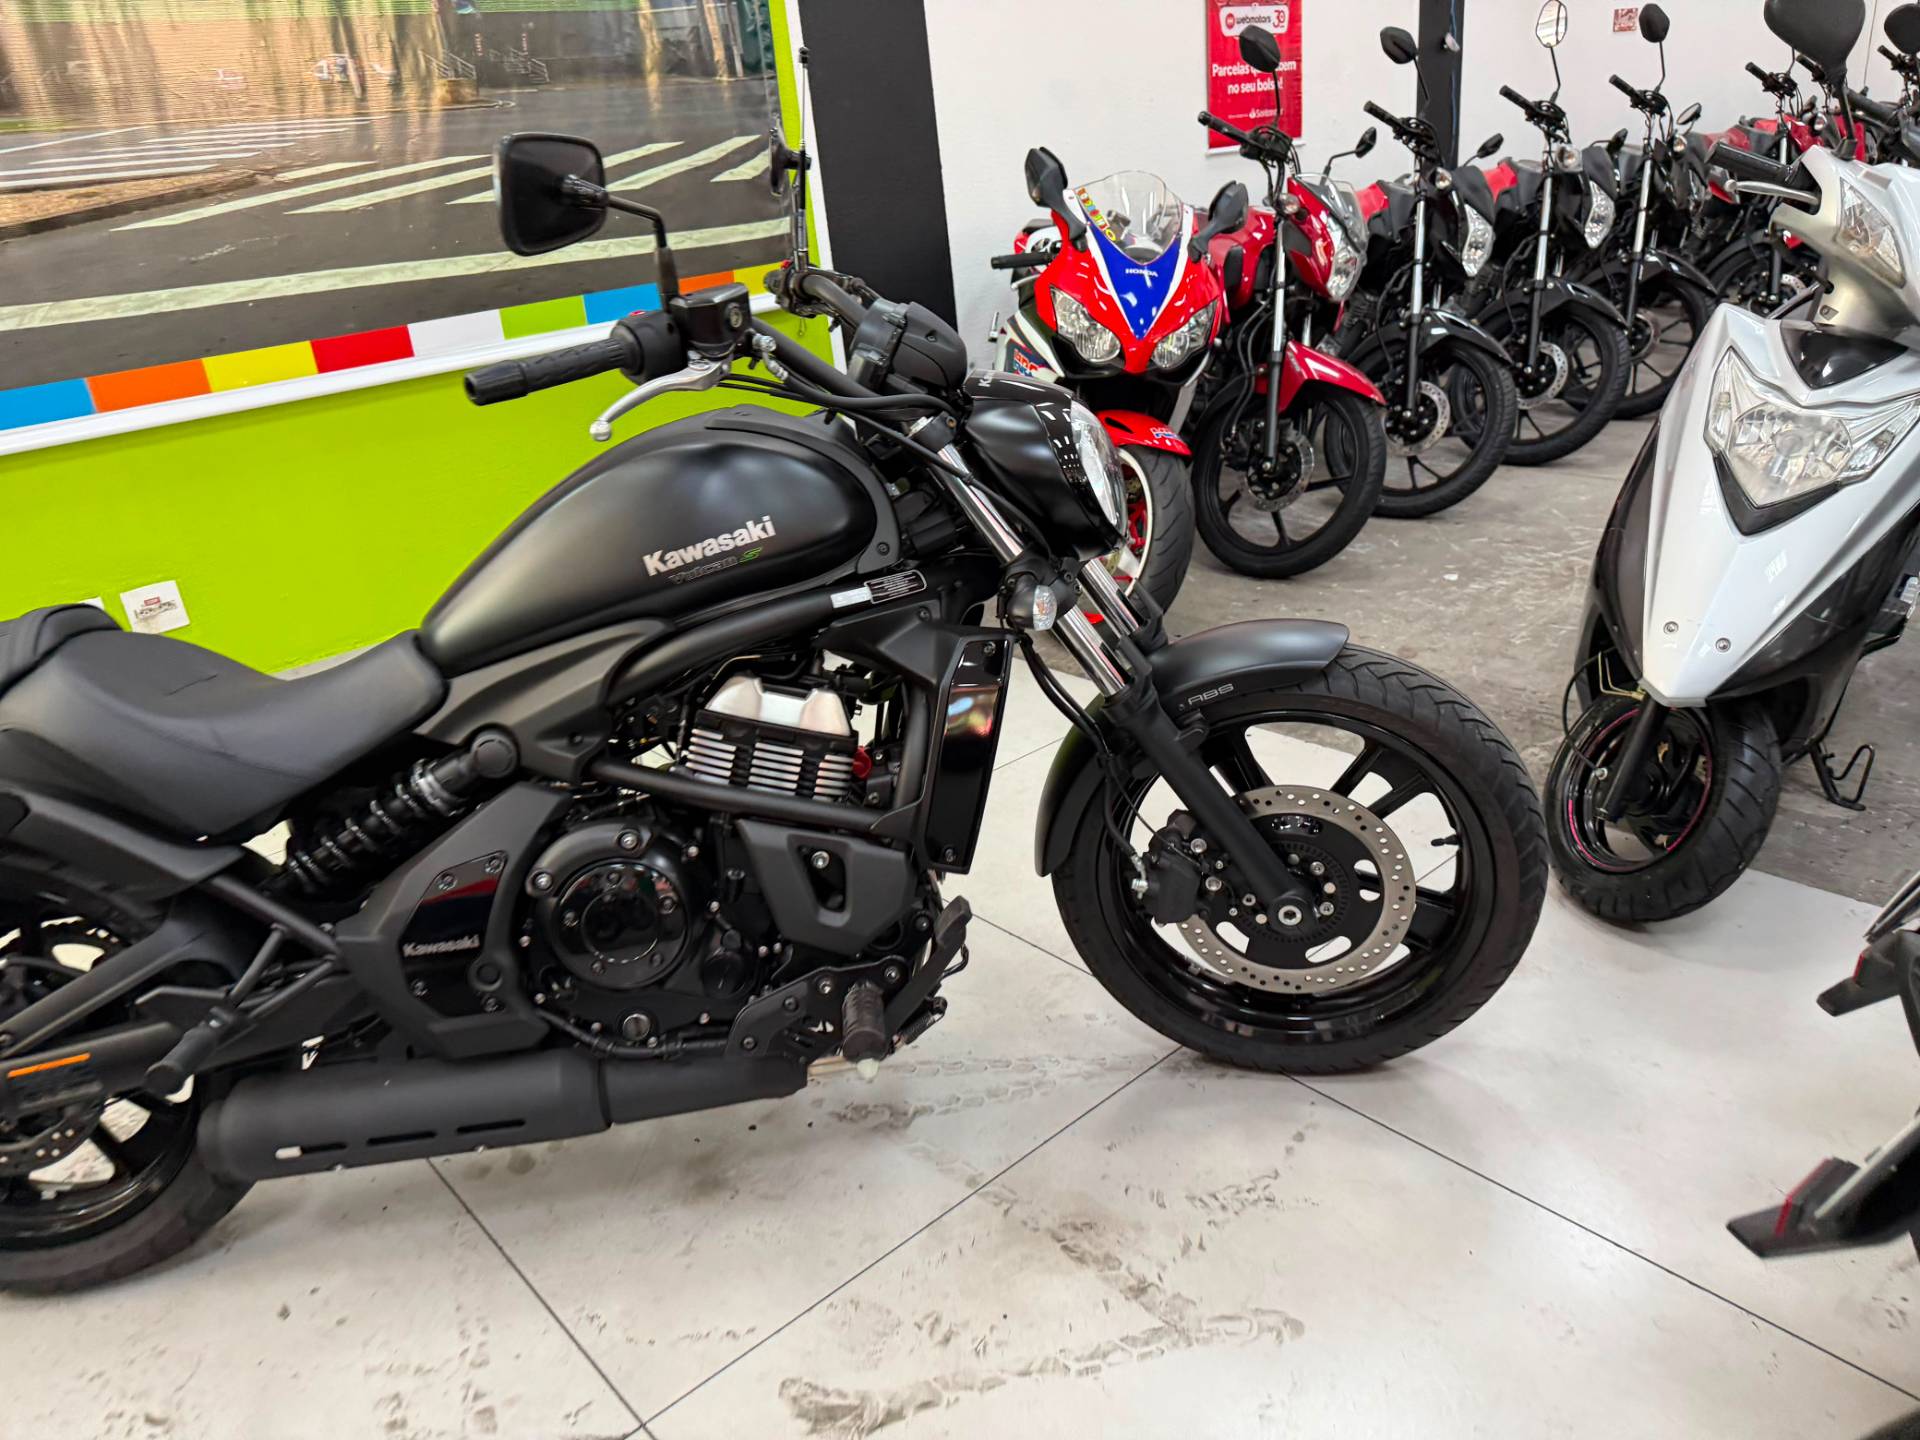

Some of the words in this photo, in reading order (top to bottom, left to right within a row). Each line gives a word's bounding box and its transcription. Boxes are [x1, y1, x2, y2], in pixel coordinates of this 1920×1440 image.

[1236, 14, 1271, 24] webmotors
[1212, 62, 1249, 77] Parcelas
[1227, 83, 1240, 95] no
[1241, 82, 1256, 93] seu
[1125, 268, 1159, 278] HONDA
[642, 515, 777, 577] Kawasaki
[1188, 683, 1235, 705] ABS
[402, 934, 481, 957] Kawasaki
